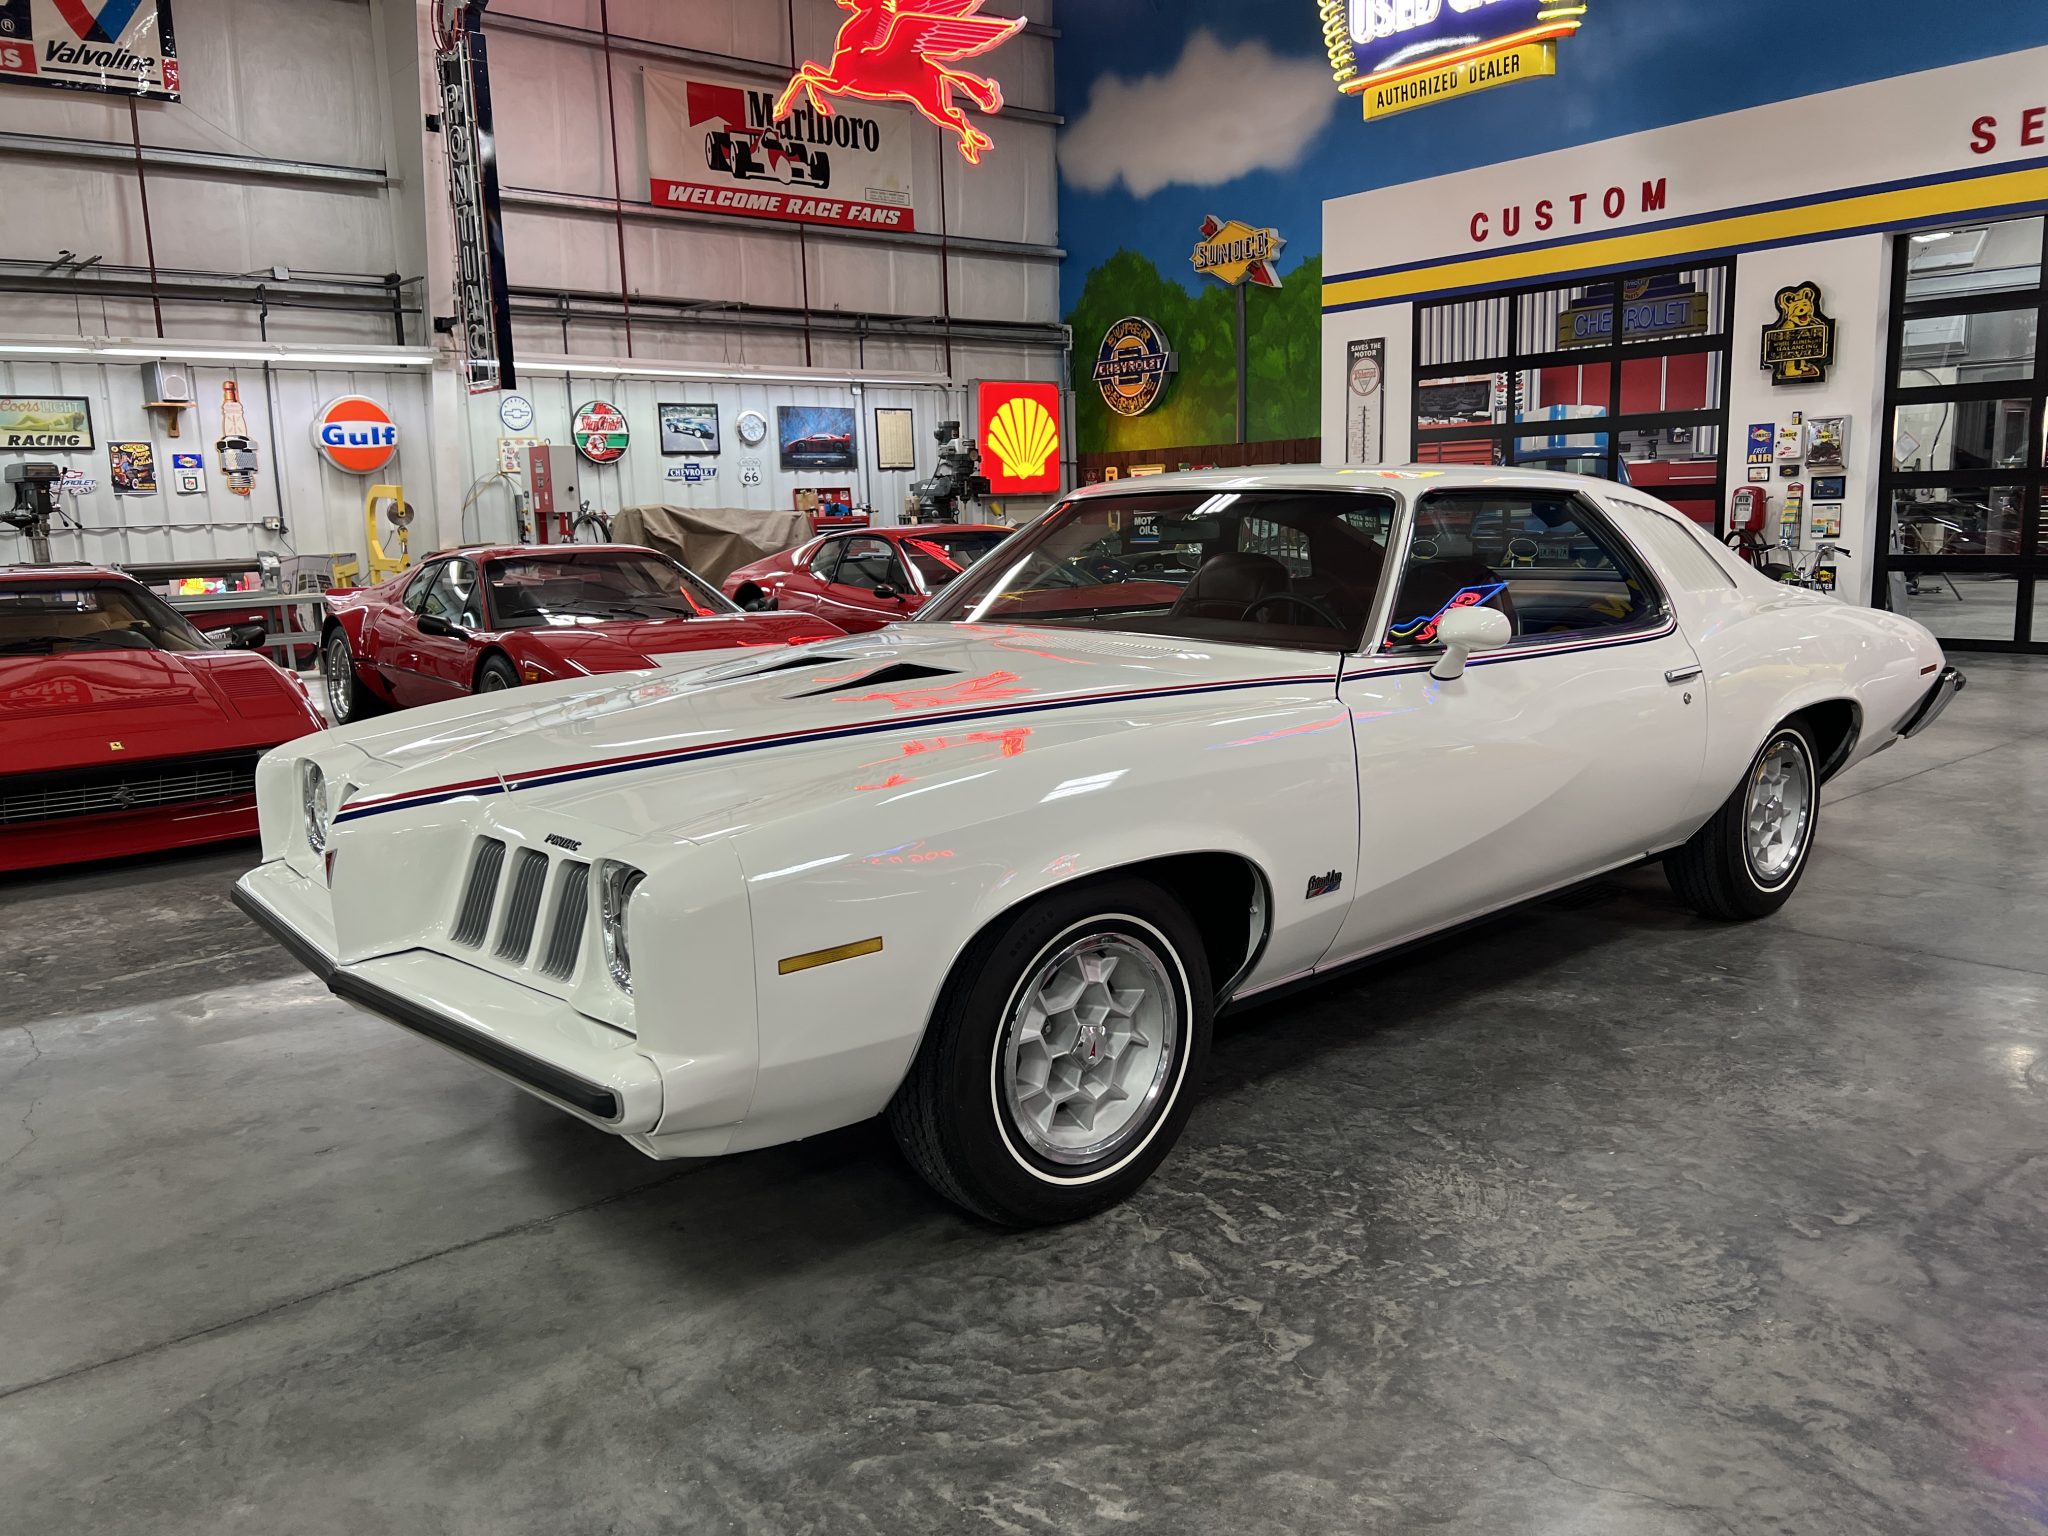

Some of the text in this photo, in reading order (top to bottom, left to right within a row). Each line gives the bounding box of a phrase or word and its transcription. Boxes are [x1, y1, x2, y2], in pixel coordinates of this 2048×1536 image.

[46, 40, 155, 73] Valvoline
[1376, 54, 1520, 109] AUTHORIZED DEALER
[747, 90, 880, 152] Marlboro
[1970, 106, 2047, 154] SE
[668, 185, 901, 225] WELCOME RACE FANS
[1470, 178, 1666, 242] CUSTOM
[1195, 232, 1269, 268] SUNOCO
[1574, 300, 1690, 337] CHEROLET
[1106, 322, 1151, 347] SUPER
[1351, 344, 1369, 352] SAVES
[1354, 350, 1377, 358] MOTOR
[1099, 358, 1162, 376] CHEVROLET
[0, 399, 81, 413] Coors LIGHT
[8, 435, 80, 446] RACING
[322, 424, 396, 446] Gulf
[1748, 453, 1772, 463] AIR
[670, 468, 715, 477] CHEVROLET
[744, 472, 760, 482] 66
[1138, 526, 1159, 535] OILS
[544, 833, 582, 851] PONTIAC
